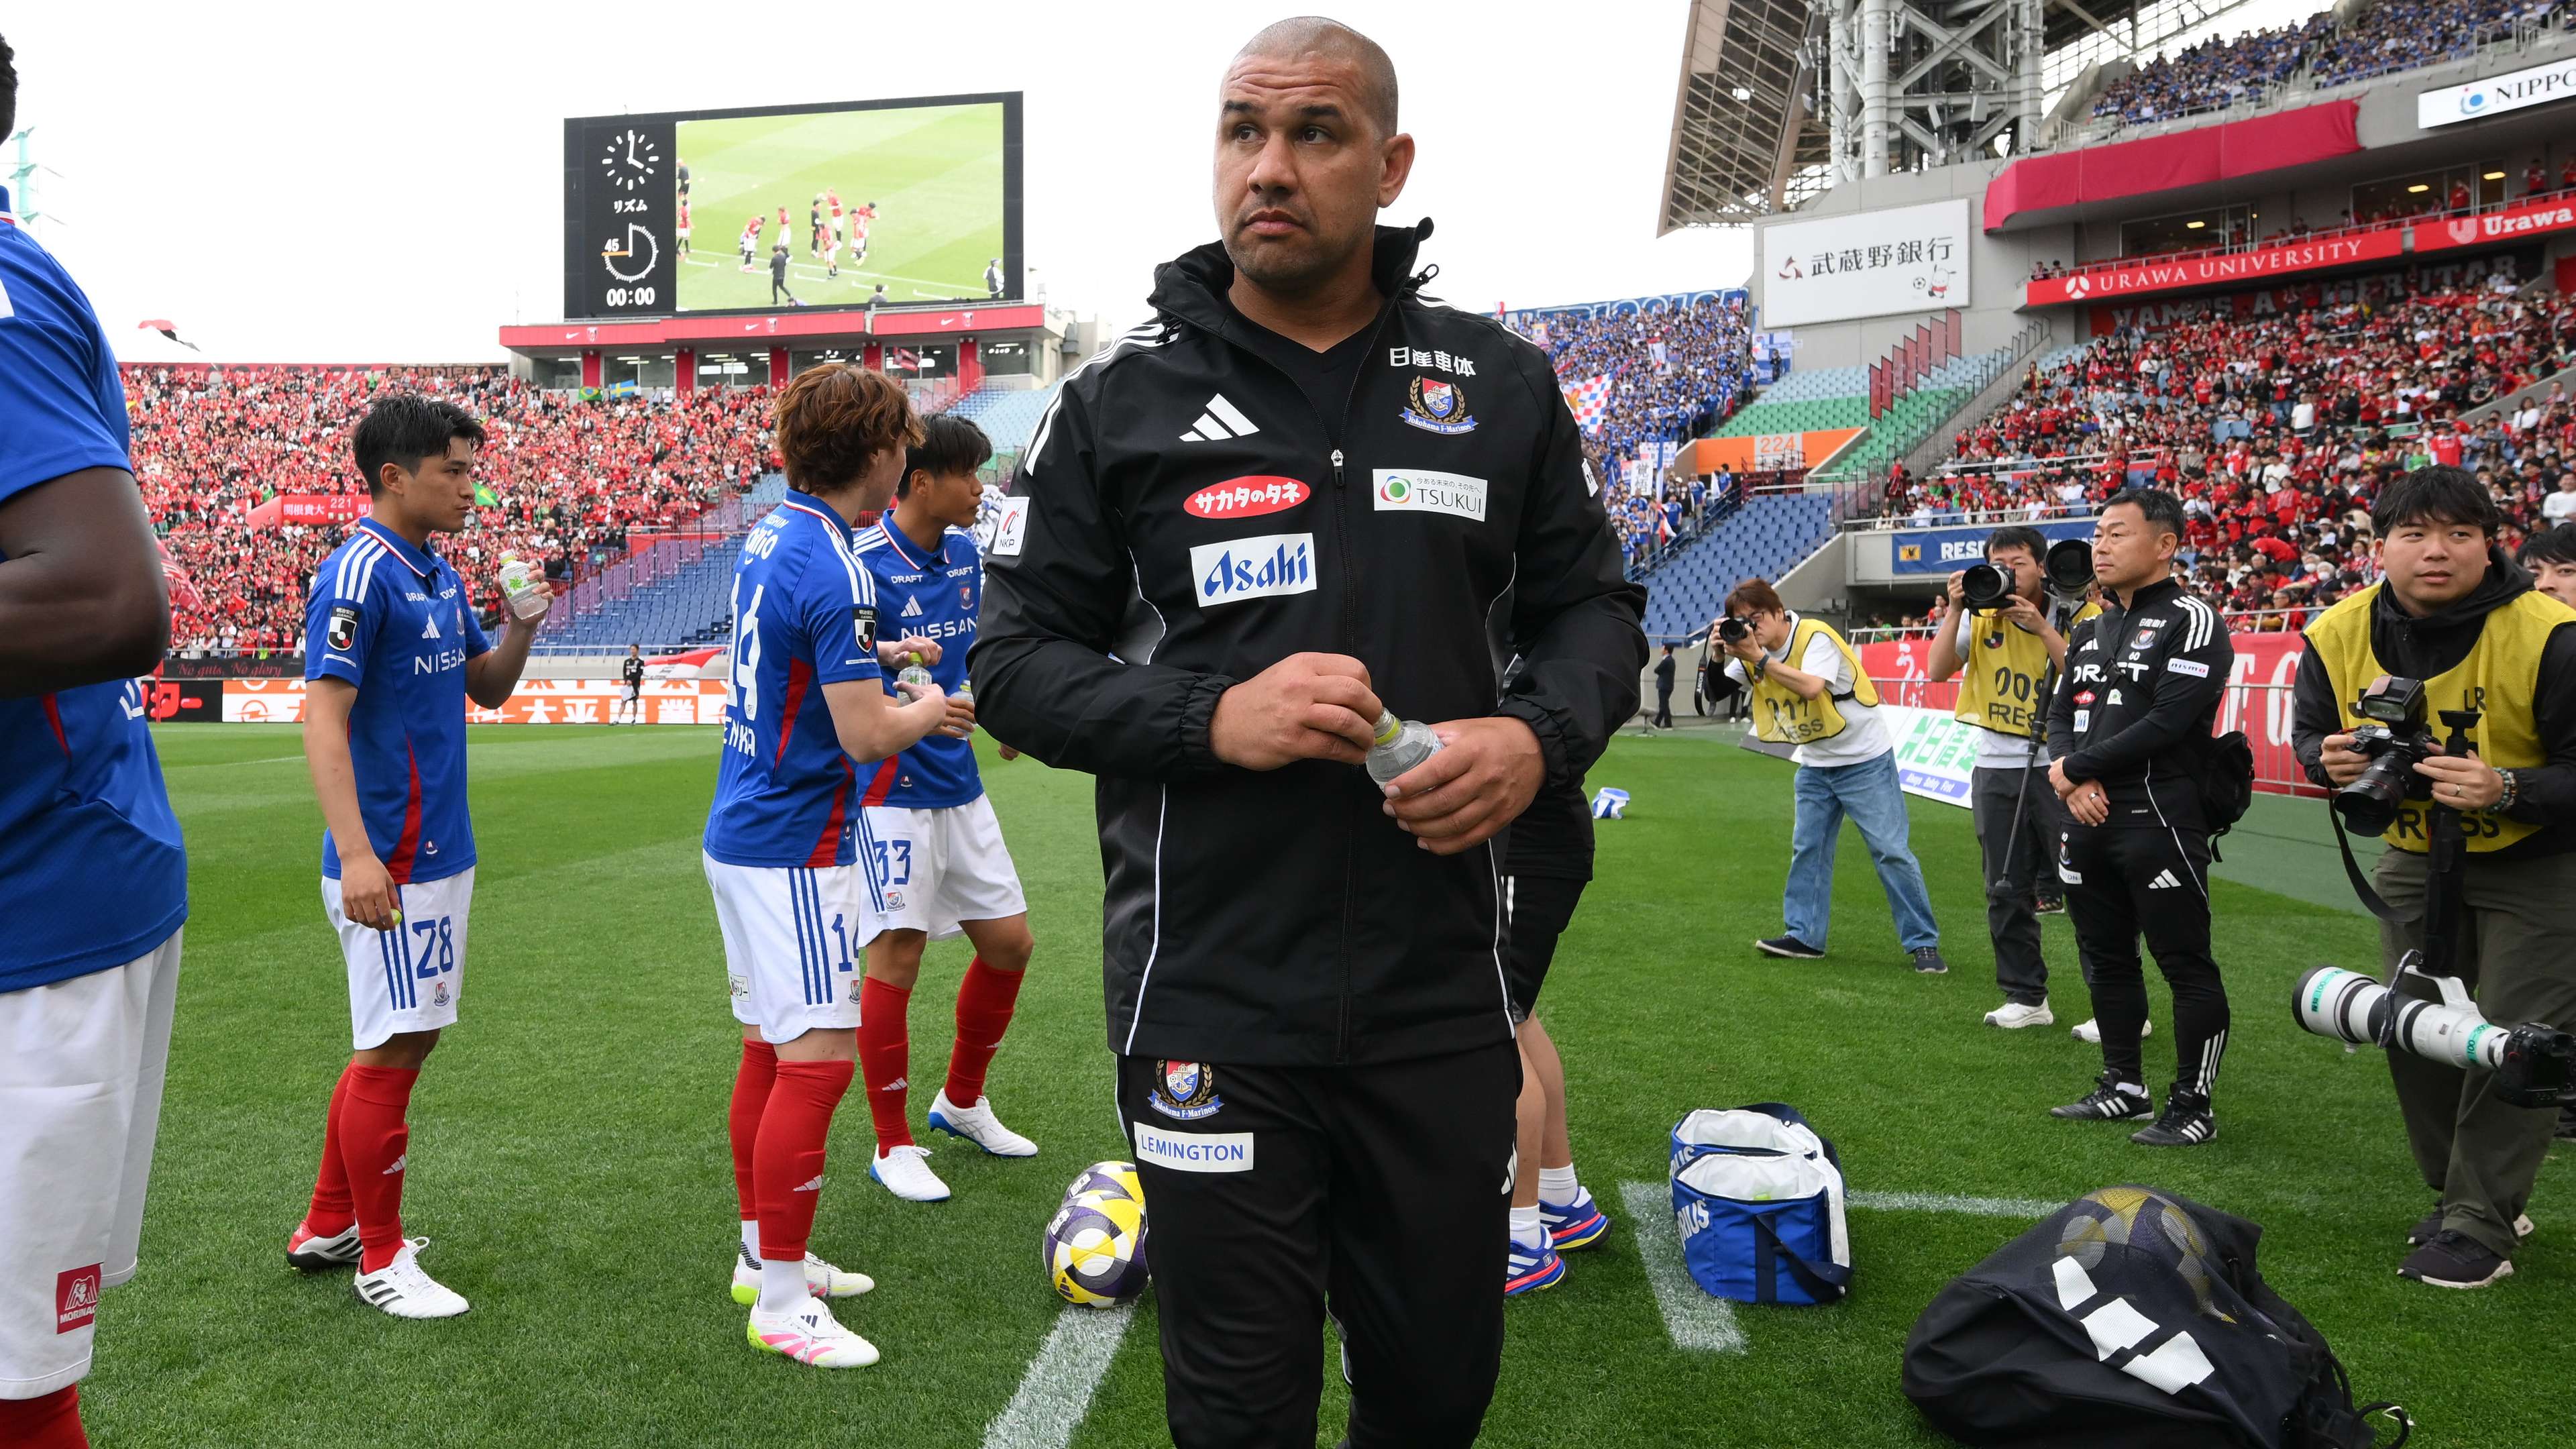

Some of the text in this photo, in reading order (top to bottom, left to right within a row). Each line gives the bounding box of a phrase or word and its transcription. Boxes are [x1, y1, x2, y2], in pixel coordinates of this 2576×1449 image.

[614, 199, 648, 214] リズム
[2483, 207, 2573, 235] Urawa
[604, 238, 620, 252] 45
[1811, 236, 1954, 277] 武蔵野銀行
[2099, 239, 2362, 291] URAWA UNIVERSITY
[606, 286, 655, 307] 00:00
[1389, 346, 1477, 377] 日産車体
[1408, 415, 1440, 431] Yokohama
[1760, 436, 1796, 453] 224
[330, 498, 352, 509] 221
[1195, 482, 1301, 514] サカタのタネ
[1416, 488, 1481, 514] TSUKUI
[999, 539, 1015, 548] NKP
[890, 574, 924, 584] DRAFT
[946, 566, 974, 578] DRAFT
[1204, 542, 1309, 597] Asahi
[2128, 651, 2141, 661] 60
[176, 661, 283, 680] No guts, No glory
[2170, 661, 2206, 674] nismo
[411, 915, 454, 979] 28
[1153, 1098, 1181, 1118] Yokohama
[1141, 1134, 1244, 1161] LEMINGTON
